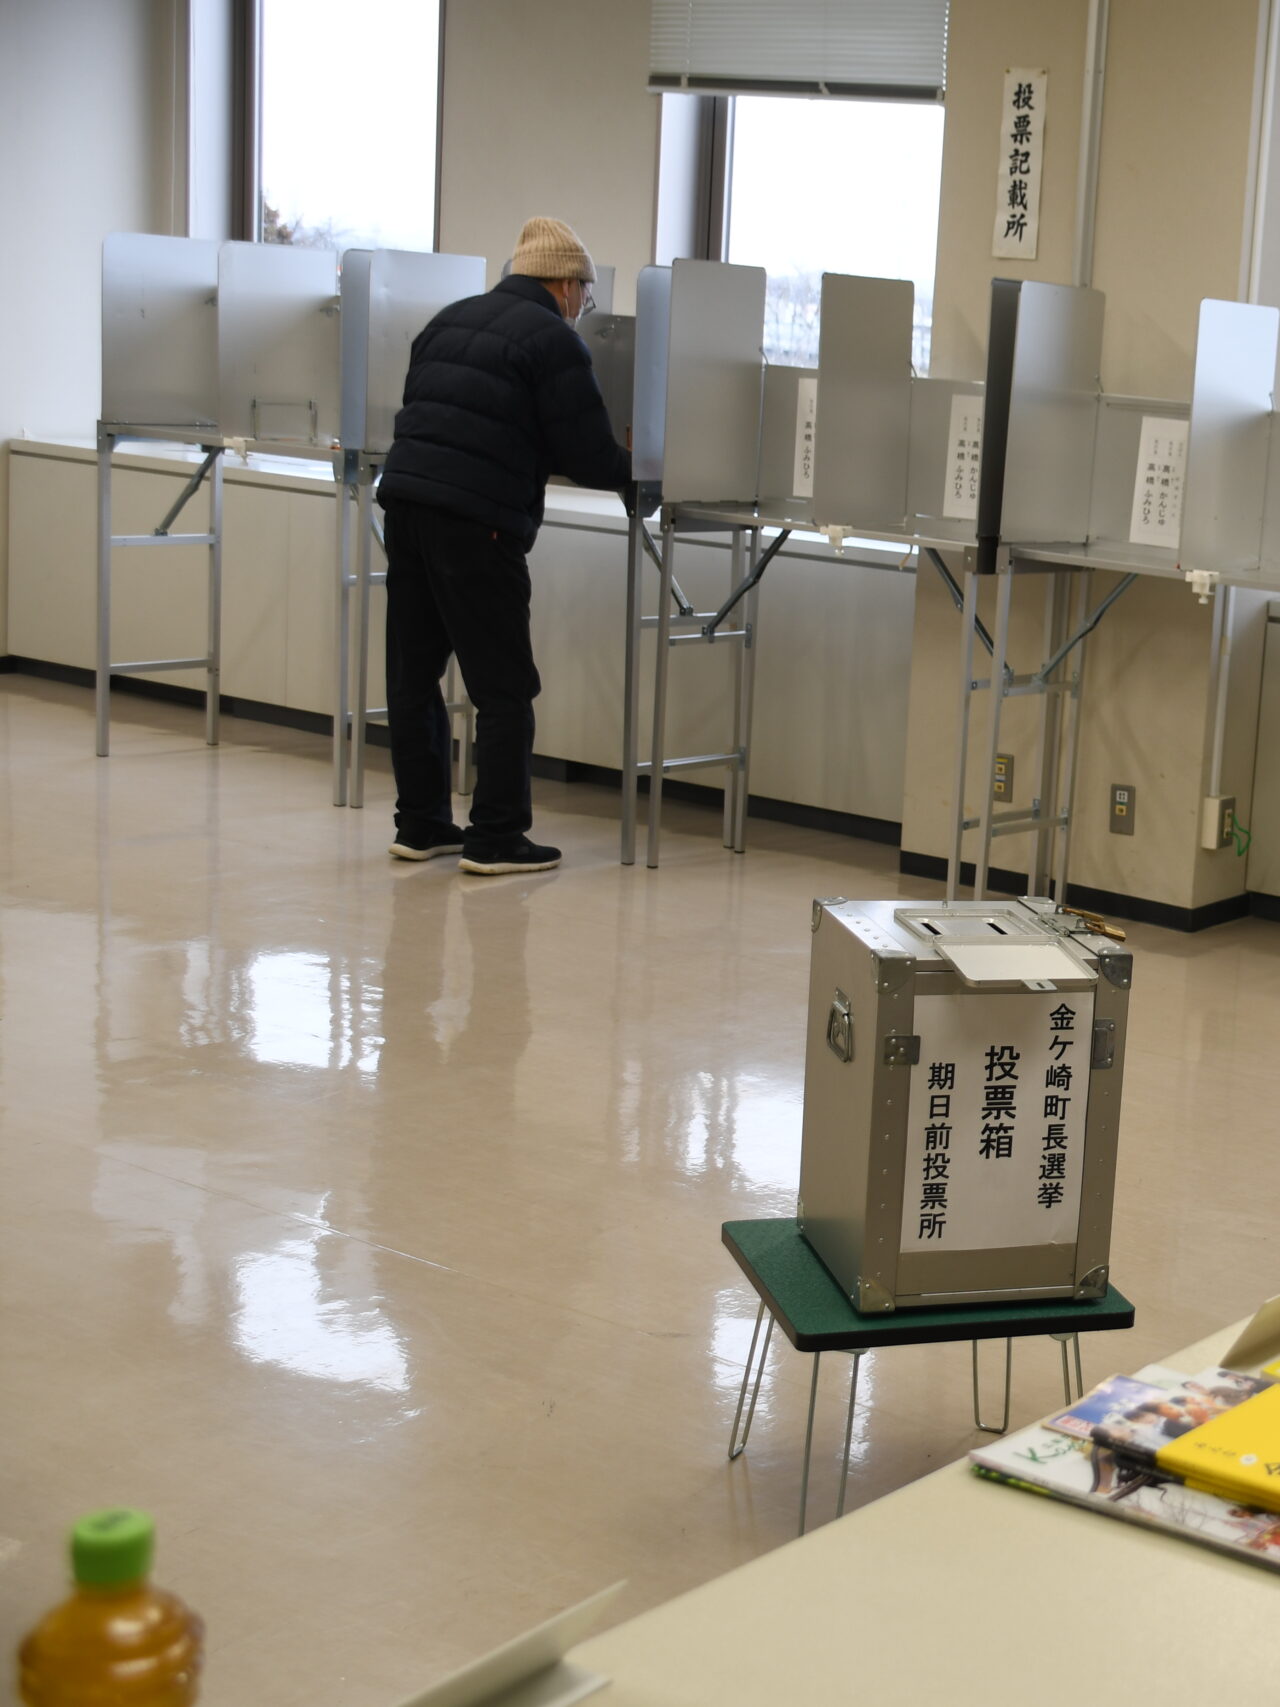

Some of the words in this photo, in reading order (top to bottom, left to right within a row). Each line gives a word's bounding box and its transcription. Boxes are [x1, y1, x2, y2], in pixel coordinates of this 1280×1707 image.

[1003, 83, 1035, 243] 投票記載所
[917, 1061, 956, 1240] 期日前投票所
[978, 1045, 1021, 1160] 投票箱
[1036, 1002, 1077, 1209] 金ケ崎町長選挙
